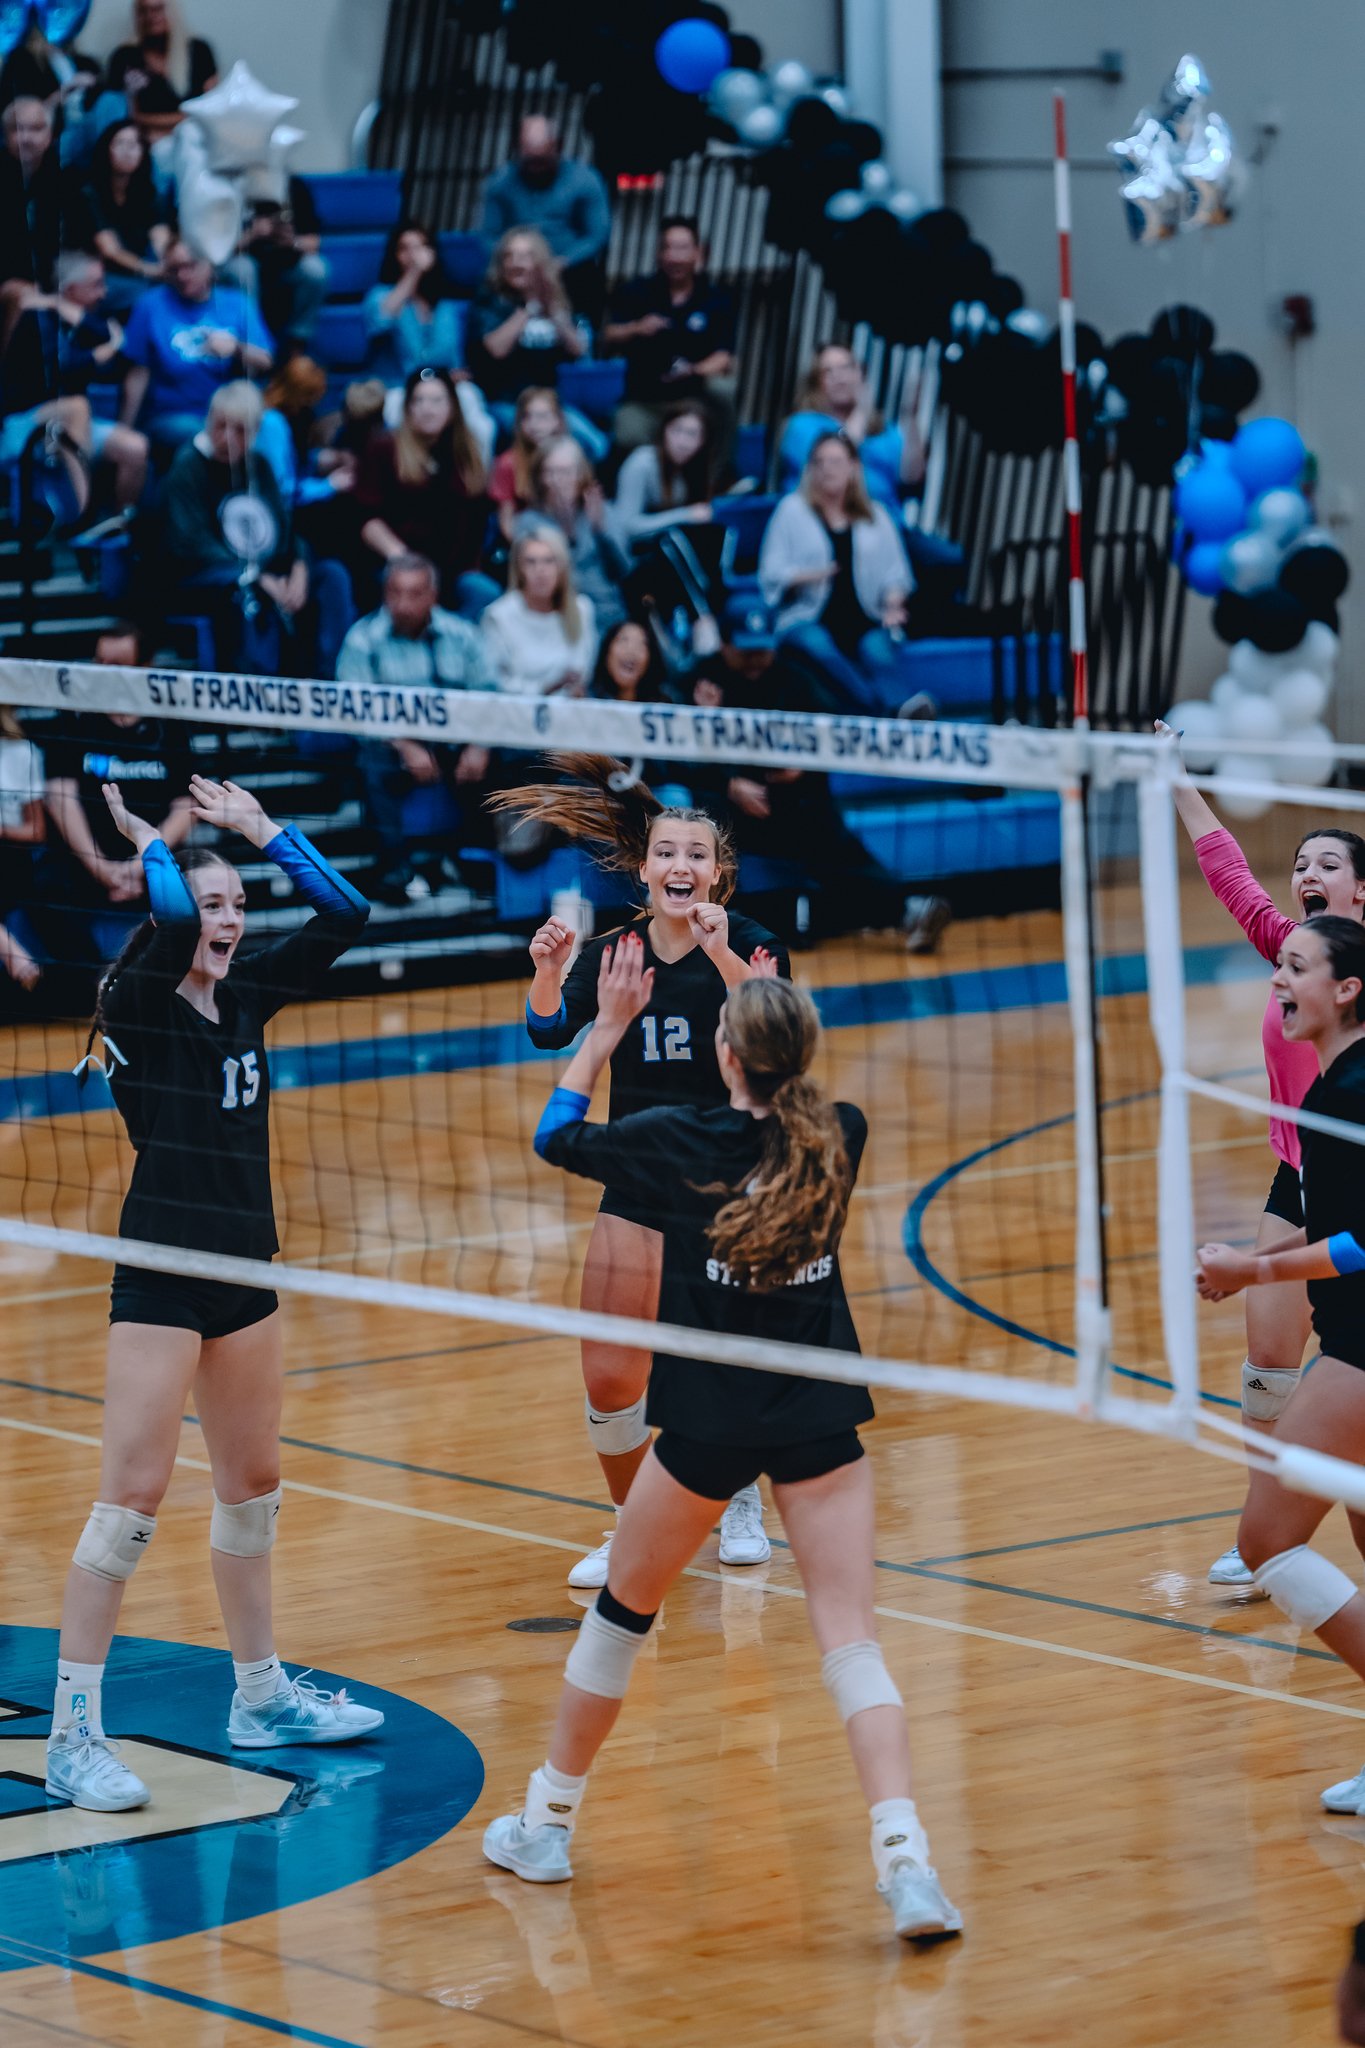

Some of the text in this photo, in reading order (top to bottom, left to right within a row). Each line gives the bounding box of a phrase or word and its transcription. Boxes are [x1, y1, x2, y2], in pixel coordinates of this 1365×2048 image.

[147, 673, 449, 727] ST. FRANCIS SPARTANS
[640, 711, 991, 768] ST. FRANCIS SPARTANS
[641, 1015, 692, 1062] 12
[222, 1050, 260, 1109] 15
